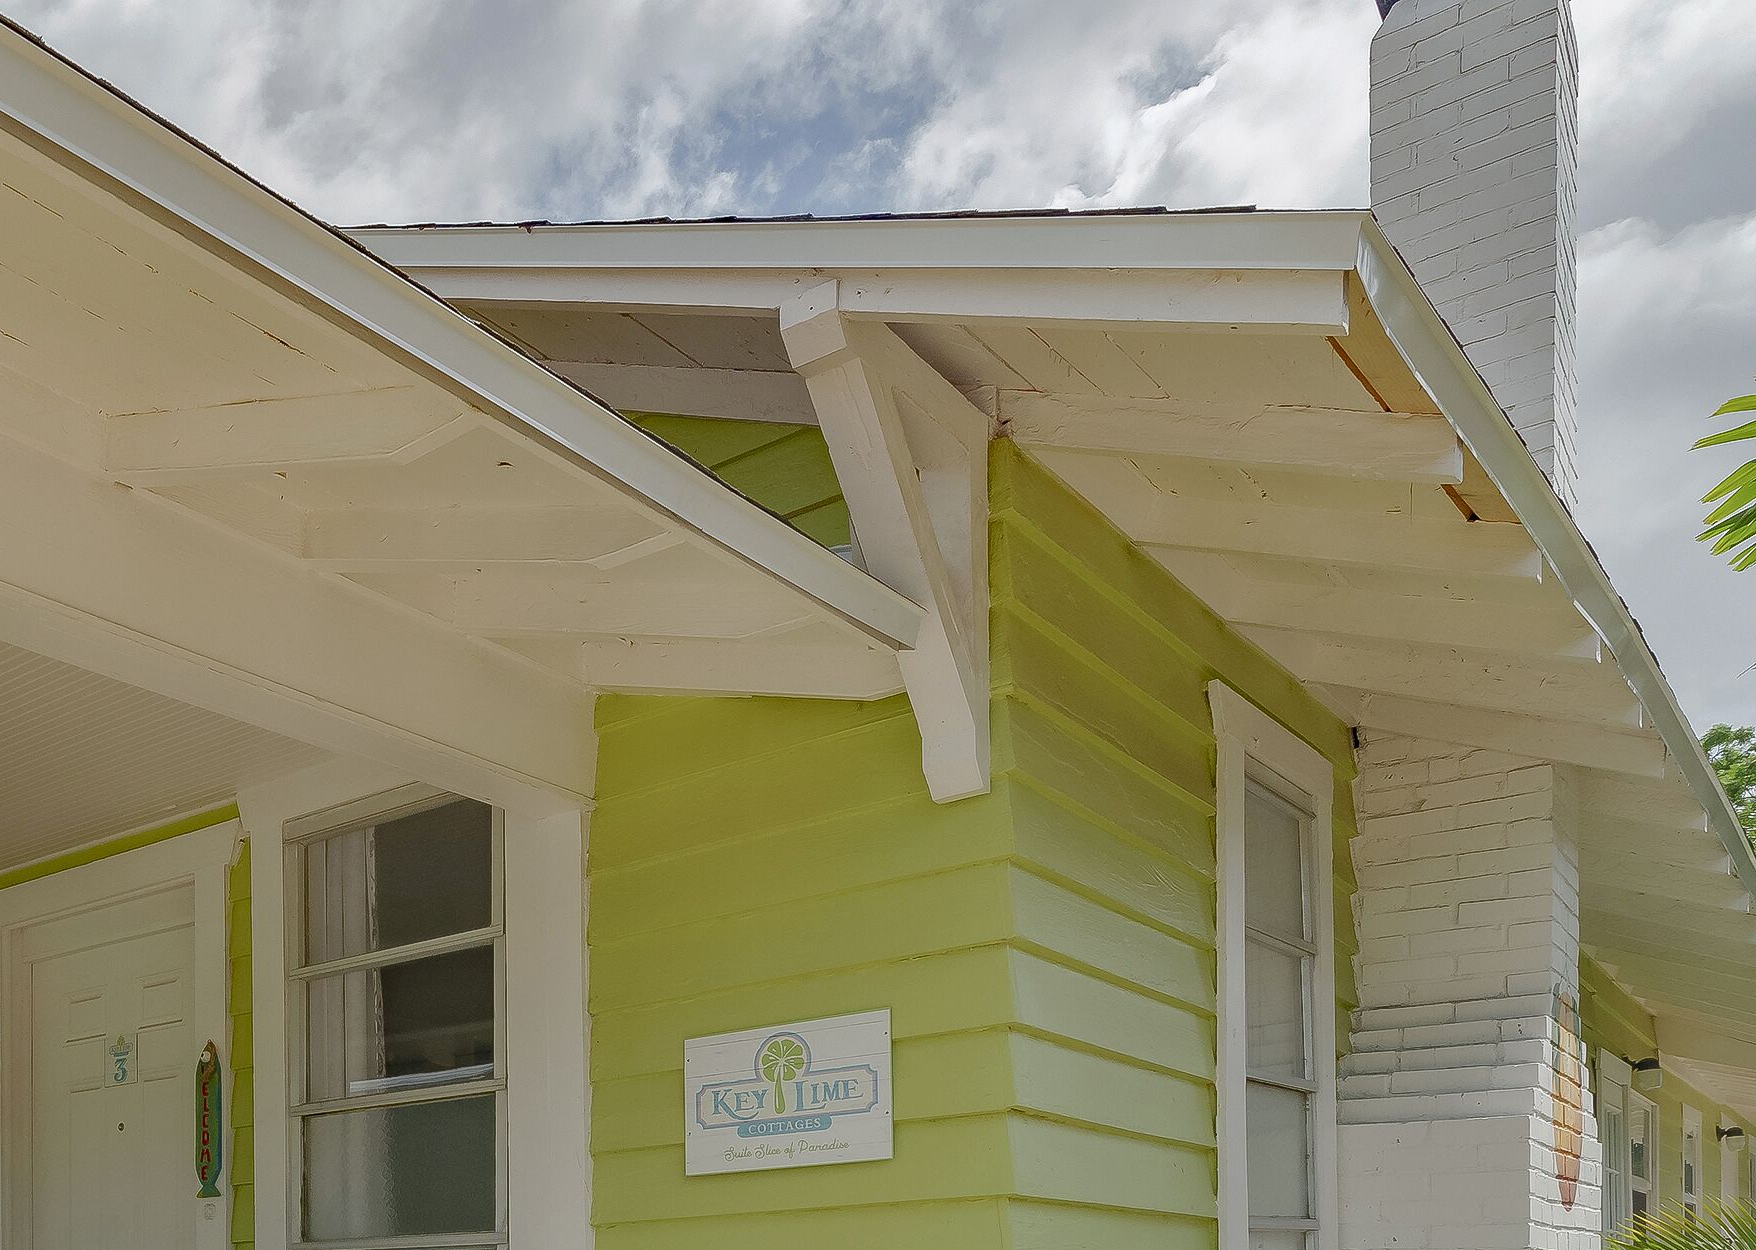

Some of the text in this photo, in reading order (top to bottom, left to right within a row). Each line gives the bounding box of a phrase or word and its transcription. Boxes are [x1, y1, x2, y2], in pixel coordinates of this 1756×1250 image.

[114, 1057, 128, 1083] 3
[711, 1079, 864, 1120] KEY LIME
[200, 1066, 212, 1181] ELCOME
[748, 1118, 821, 1135] COTTAGES
[724, 1138, 850, 1162] Suite Slice of Paradise
